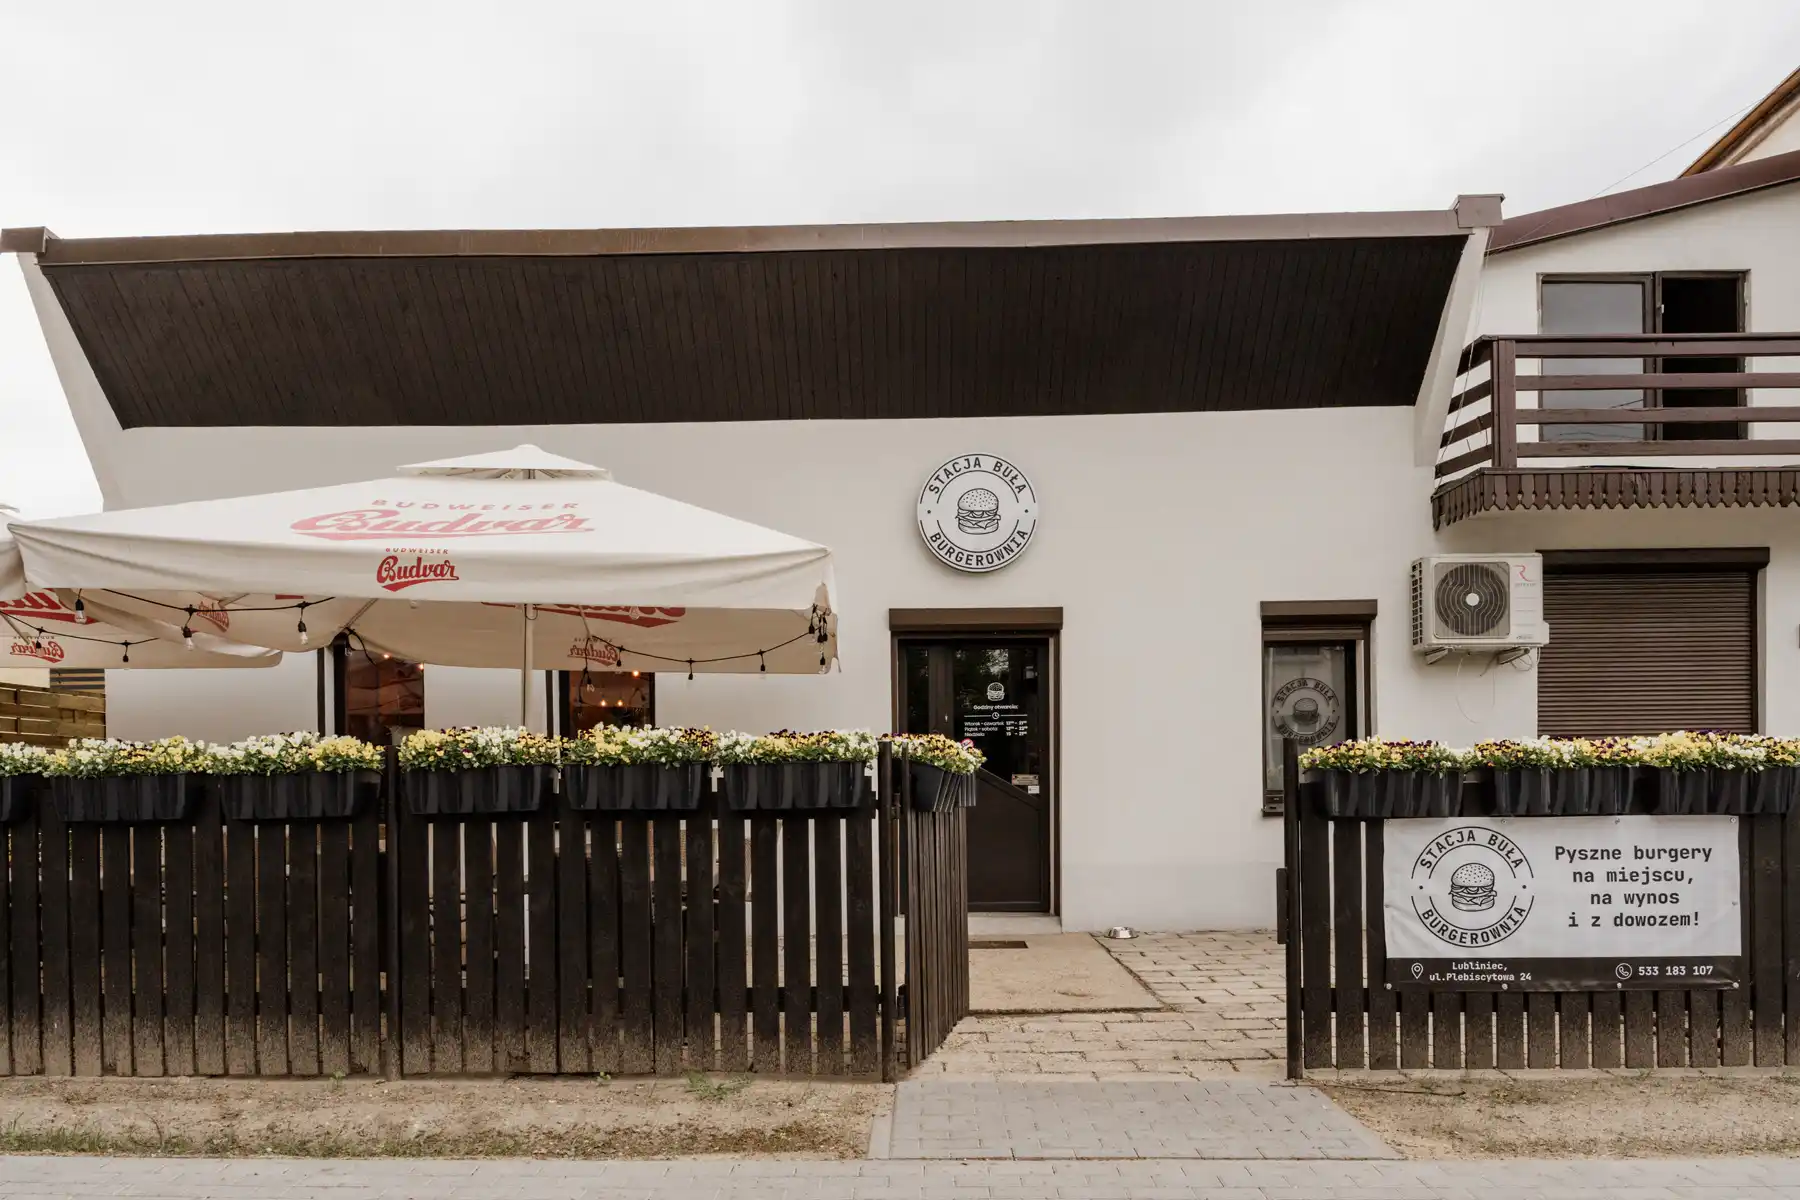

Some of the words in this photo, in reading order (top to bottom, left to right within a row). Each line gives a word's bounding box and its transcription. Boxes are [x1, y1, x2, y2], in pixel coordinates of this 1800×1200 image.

[928, 457, 982, 494] STACJA
[993, 461, 1027, 494] BUŁA
[371, 499, 580, 510] BUDWEISER
[290, 509, 595, 540] Budvar
[385, 547, 449, 555] BUDWEISER
[930, 529, 1029, 566] BURGEROWNIA
[376, 555, 460, 592] Budvar
[1277, 680, 1308, 701] STACJA
[1420, 830, 1476, 869] STACJA
[1488, 833, 1523, 869] BUŁA
[1554, 846, 1622, 863] Pyszne
[1634, 845, 1713, 862] burgery
[1572, 870, 1594, 883] na
[1607, 867, 1694, 885] miejscu,
[1590, 893, 1612, 905] na
[1624, 892, 1680, 907] wynos
[1422, 906, 1526, 945] BURGEROWNIA
[1568, 912, 1579, 927] i
[1591, 916, 1601, 927] z
[1613, 912, 1700, 927] dowozem!
[1452, 962, 1508, 972] Lubliniec,
[1638, 966, 1659, 975] 533
[1666, 966, 1686, 975] 183
[1693, 966, 1714, 975] 107
[1429, 973, 1515, 982] ul.Plebiscytowa
[1520, 973, 1532, 981] 24
